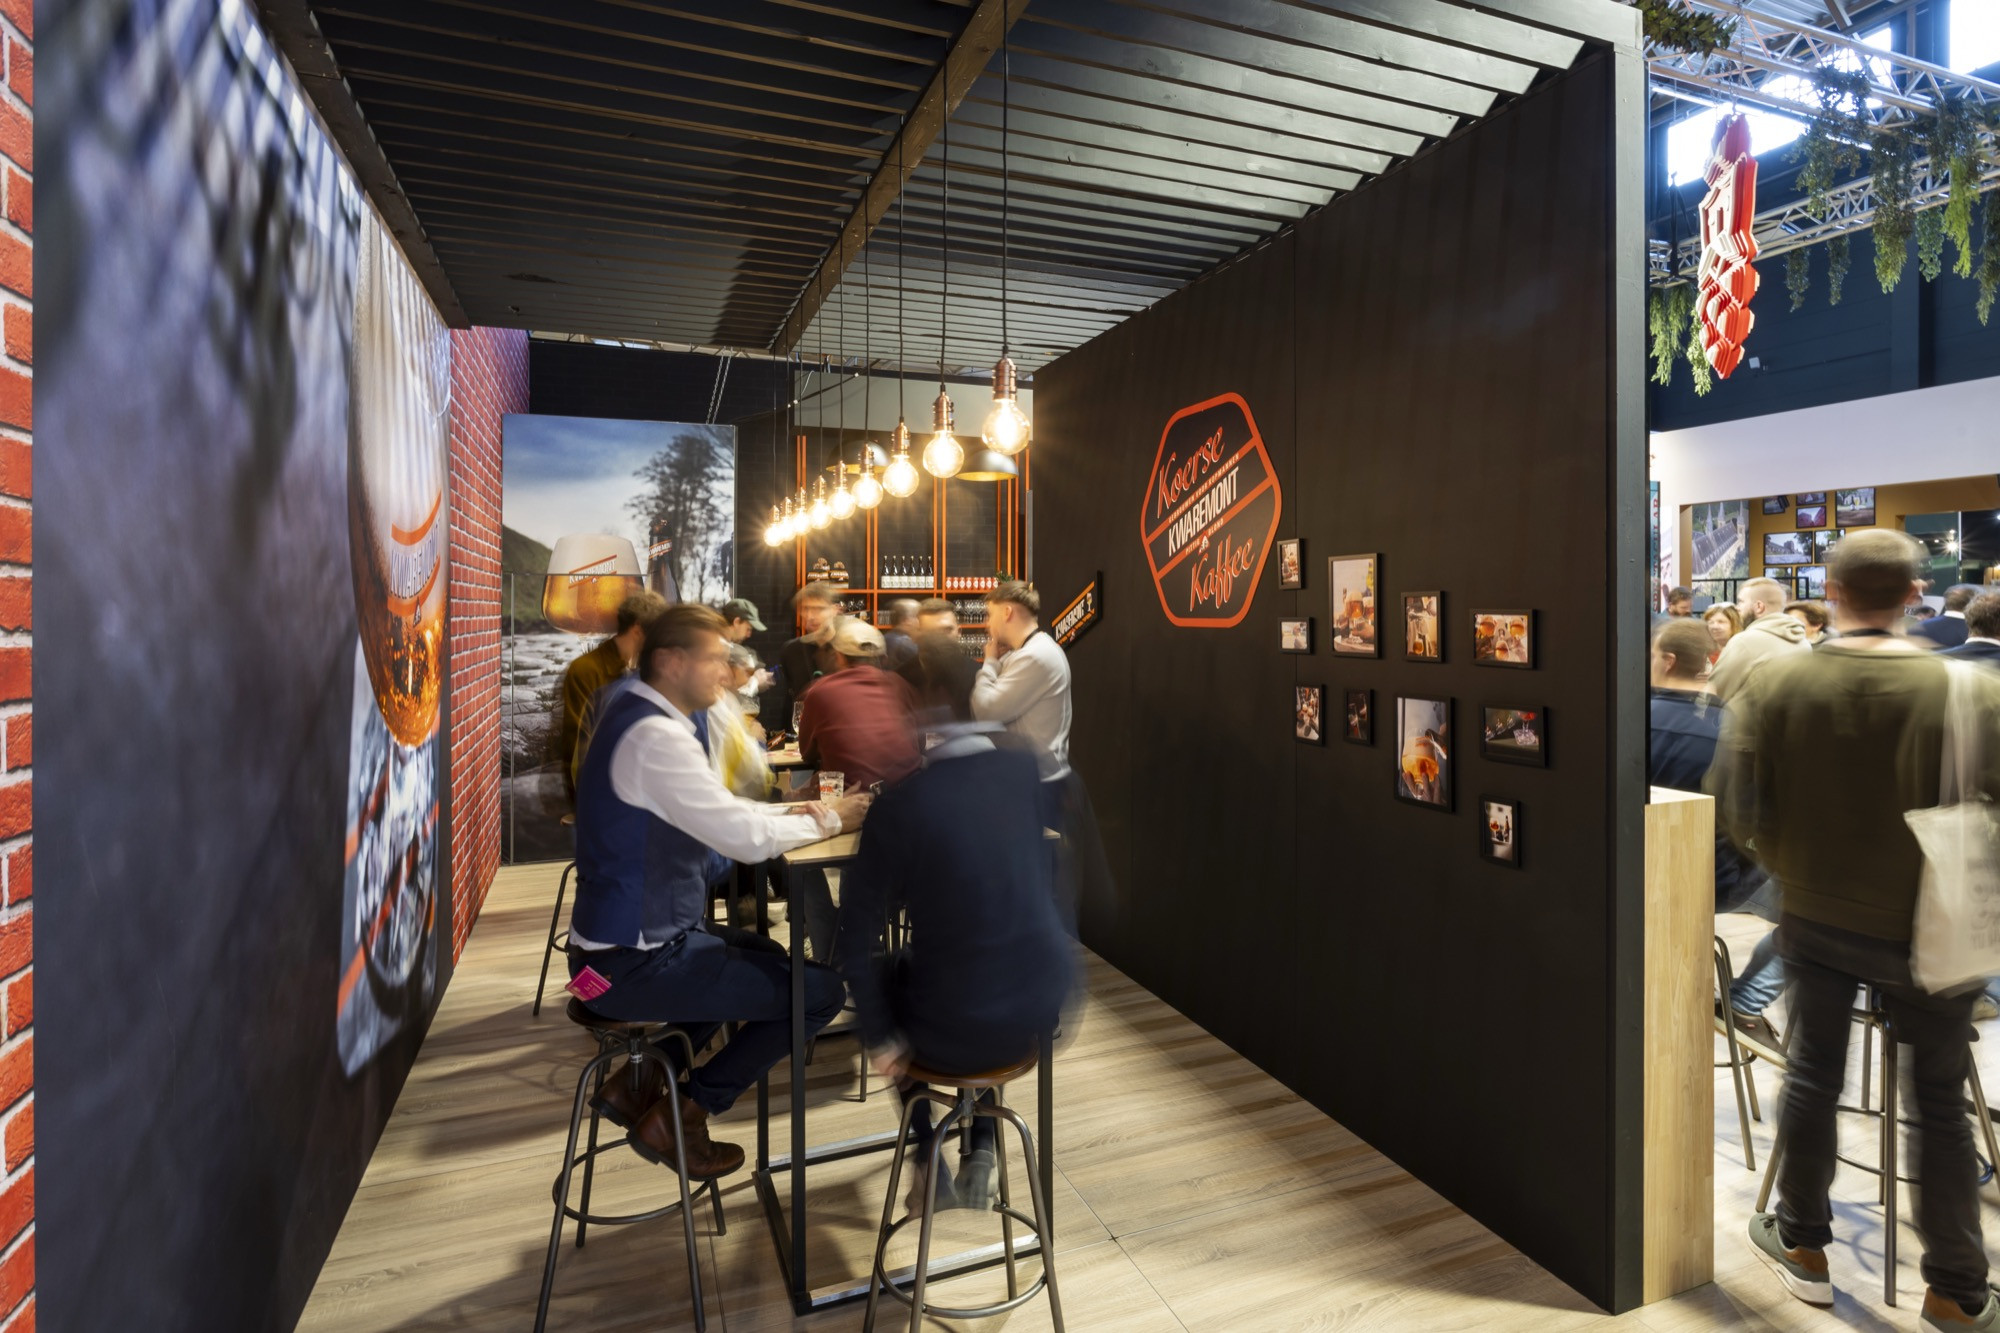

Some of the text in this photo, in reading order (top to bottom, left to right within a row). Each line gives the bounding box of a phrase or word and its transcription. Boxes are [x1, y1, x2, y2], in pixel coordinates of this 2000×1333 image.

[1157, 426, 1225, 519] Koerse
[1168, 466, 1239, 557] KWAREMONT
[390, 513, 441, 600] KWAREMONT
[1189, 534, 1255, 612] Kaffee
